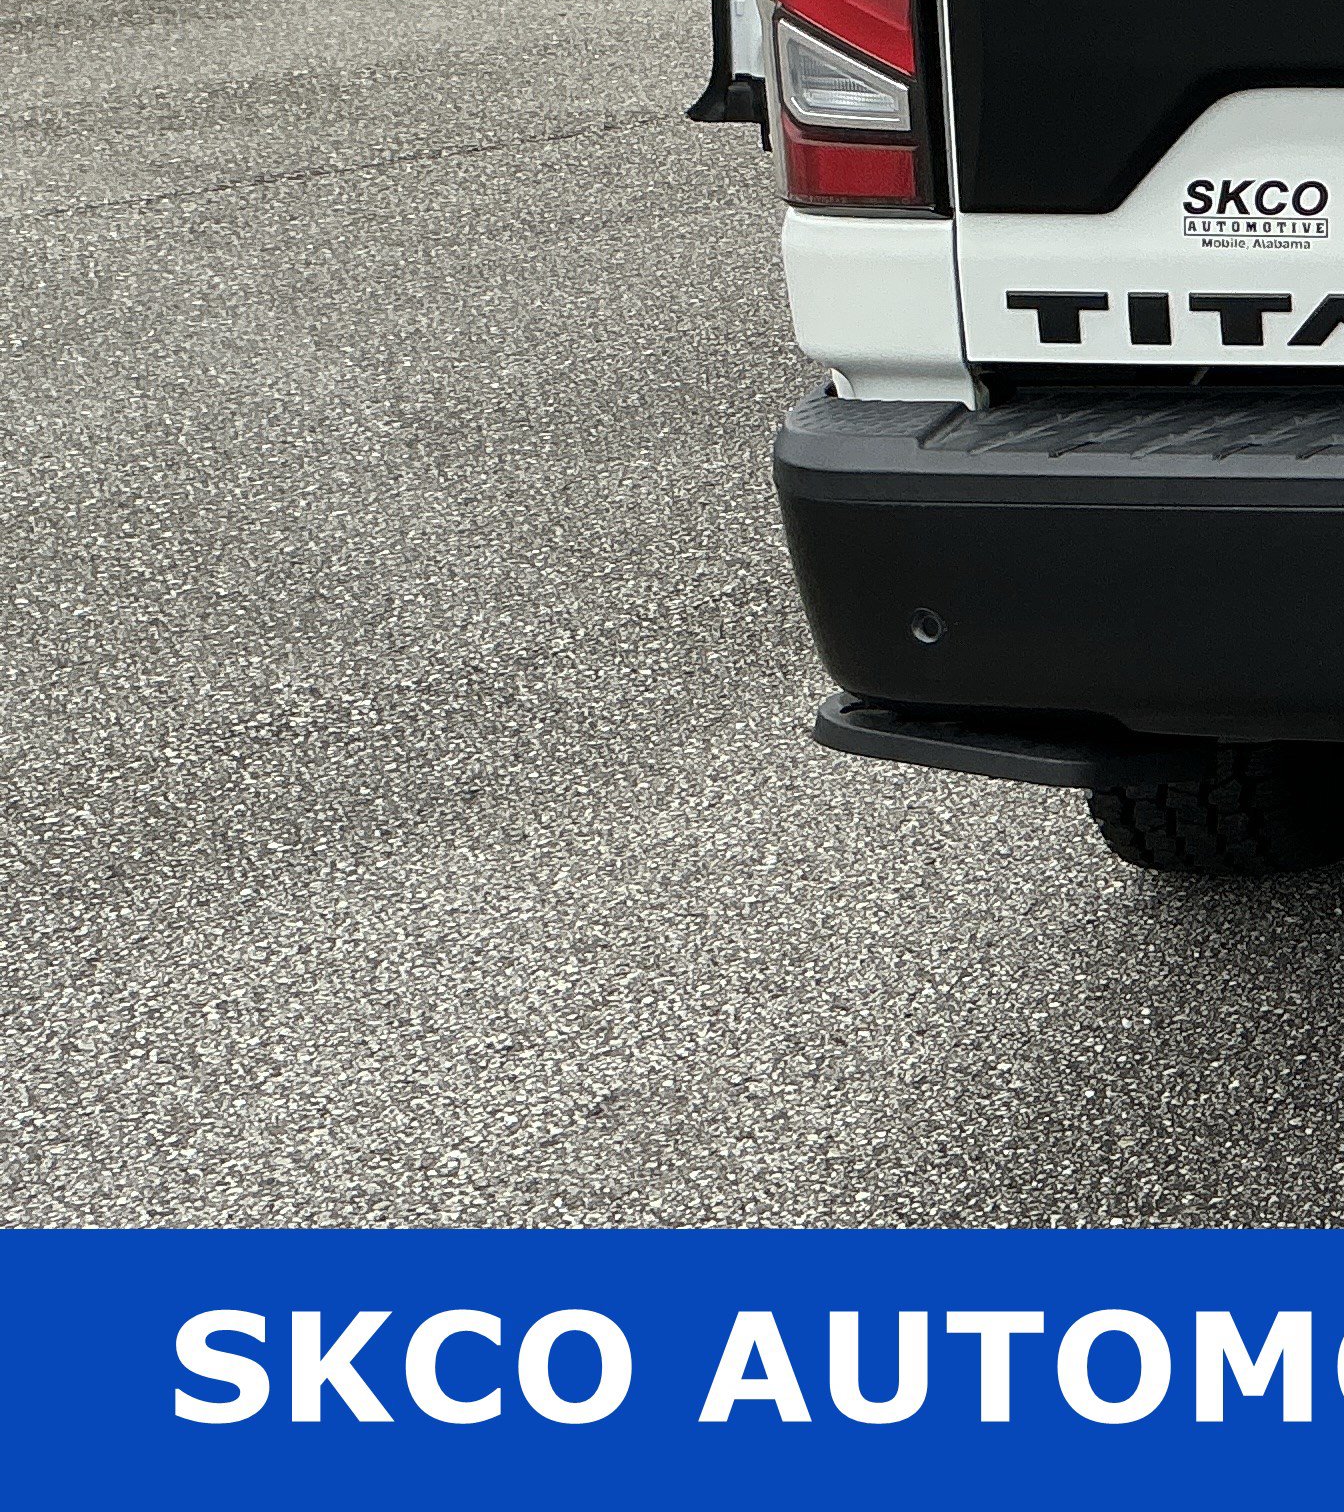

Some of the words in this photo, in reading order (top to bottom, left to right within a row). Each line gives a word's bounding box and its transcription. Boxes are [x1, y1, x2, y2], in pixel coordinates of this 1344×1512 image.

[1182, 179, 1330, 217] SKCO
[1187, 220, 1326, 234] AUTOMOTIVE
[1201, 238, 1250, 250] Mobile,
[1252, 238, 1312, 250] Alabama
